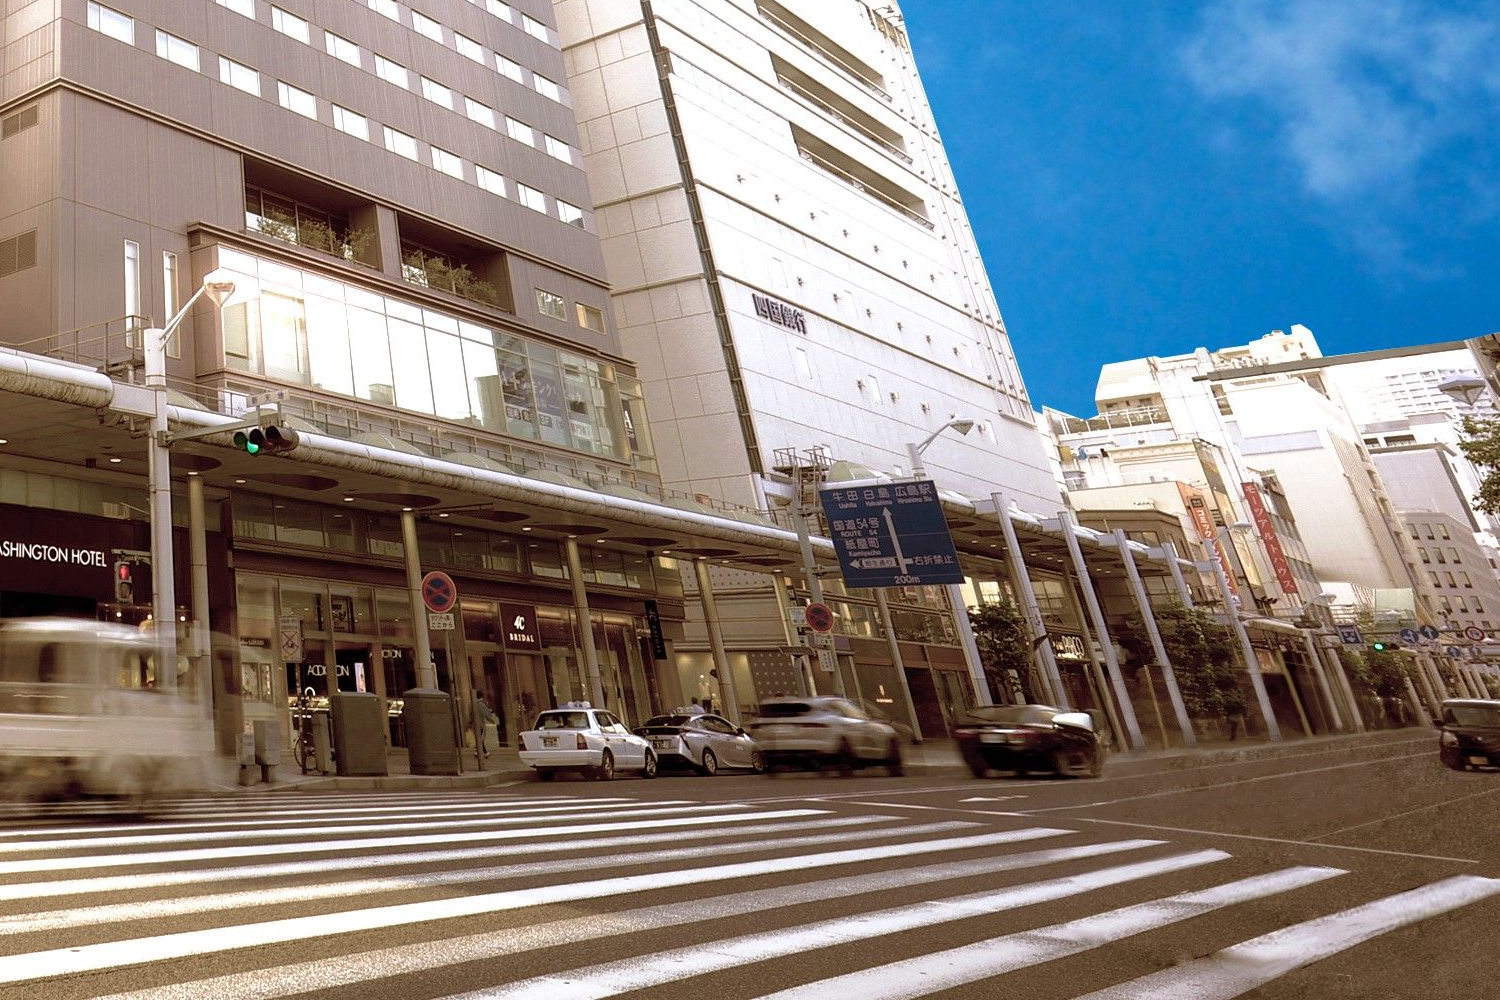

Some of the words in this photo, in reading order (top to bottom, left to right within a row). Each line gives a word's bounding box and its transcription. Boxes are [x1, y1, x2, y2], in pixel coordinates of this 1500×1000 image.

[752, 293, 807, 335] 四国銀行
[832, 491, 859, 502] 牛田
[895, 484, 932, 497] 広島駅
[833, 517, 880, 532] 国道54号
[71, 549, 107, 567] HOTEL
[915, 555, 954, 566] 右折禁止
[894, 575, 921, 585] 200m
[513, 615, 526, 631] 4C
[509, 632, 535, 643] BRIDAL
